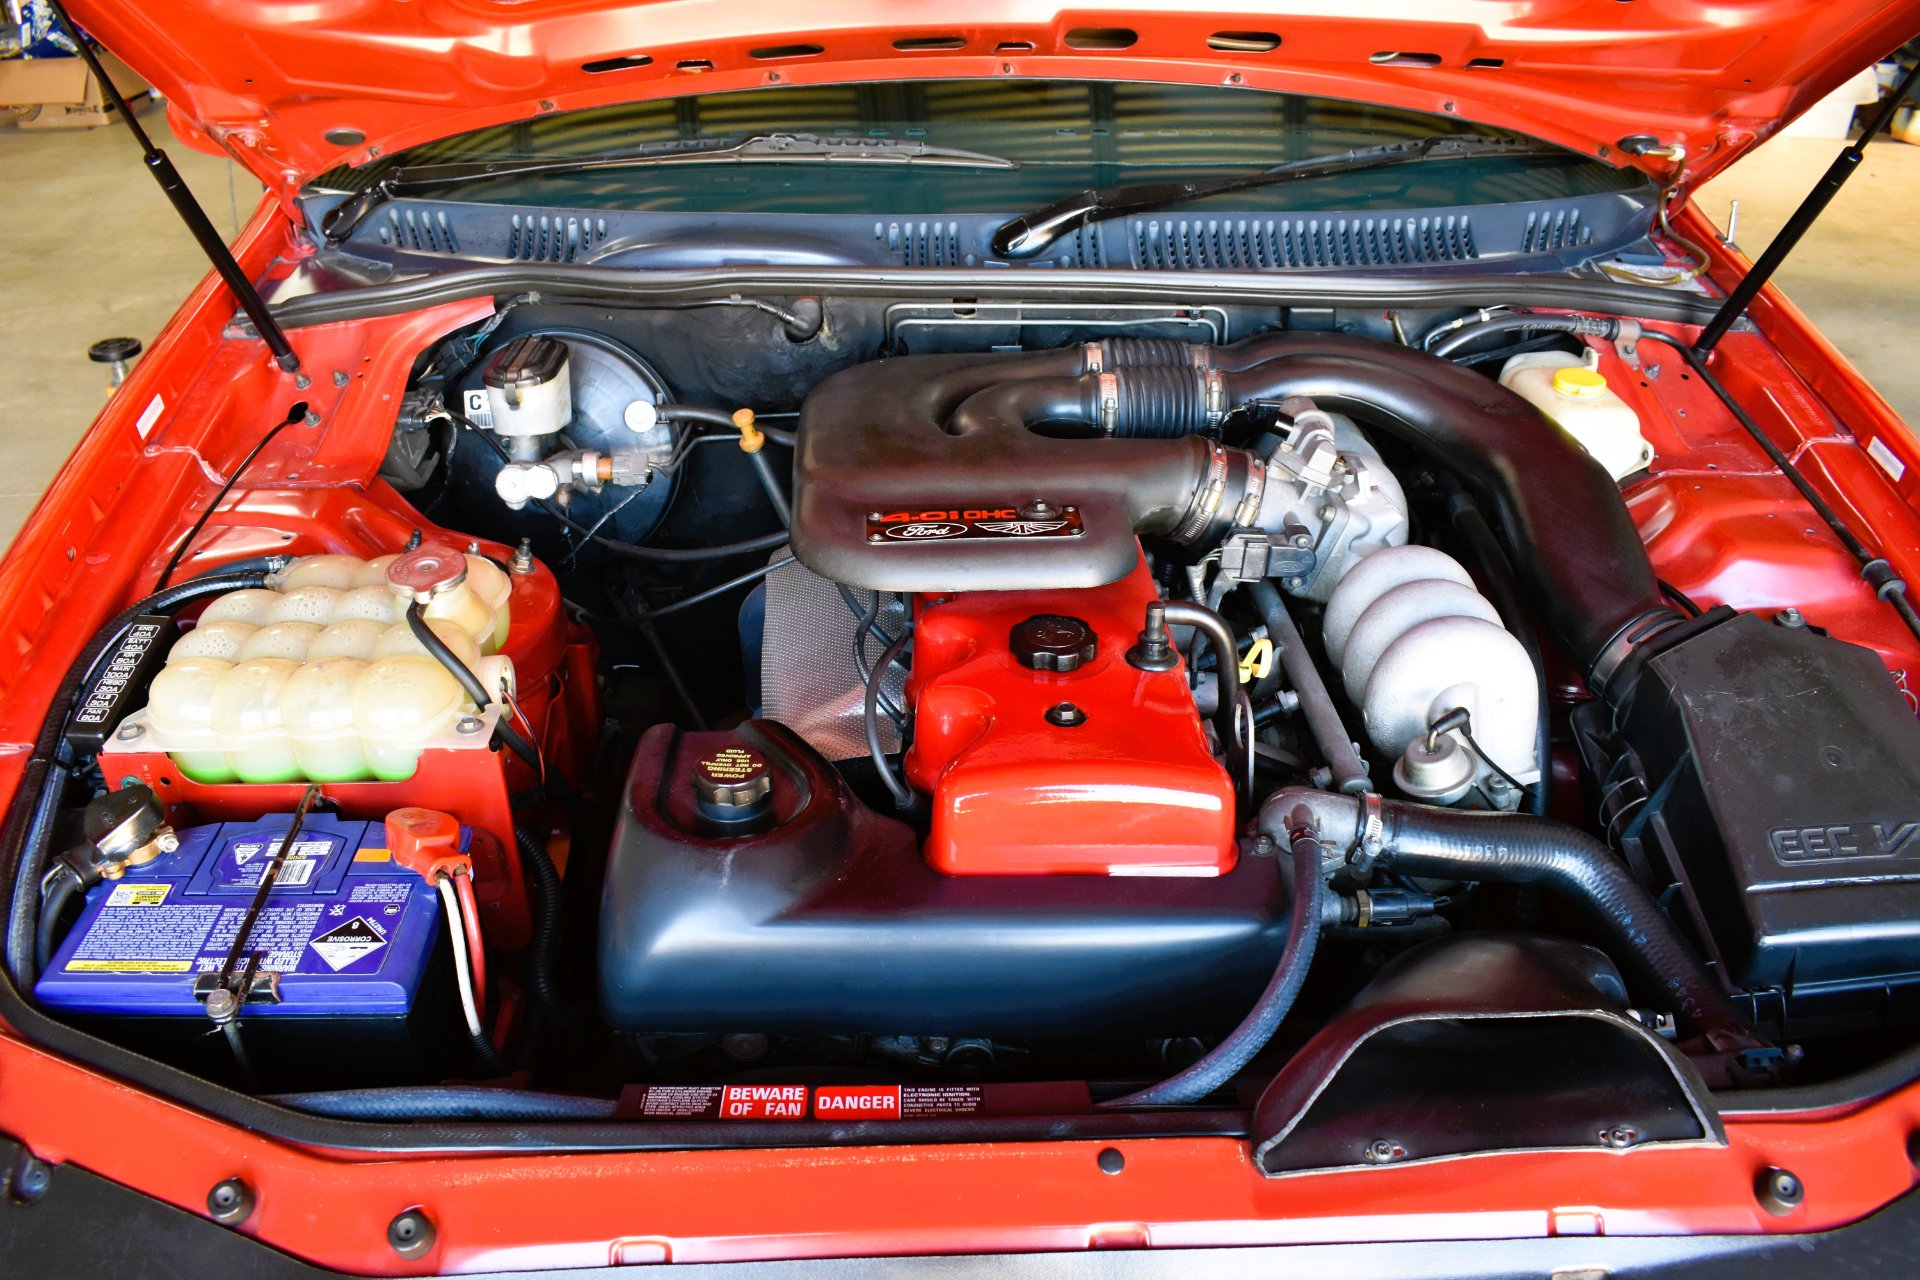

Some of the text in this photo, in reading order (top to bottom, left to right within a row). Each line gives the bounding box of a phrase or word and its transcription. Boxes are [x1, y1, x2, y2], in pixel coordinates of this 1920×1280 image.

[470, 394, 482, 410] C
[964, 510, 1016, 519] OHC
[903, 525, 949, 536] Ford
[1772, 826, 1859, 858] EEC
[729, 1087, 804, 1100] BEWARE
[730, 1103, 801, 1116] OF FAN
[818, 1096, 895, 1110] DANGER
